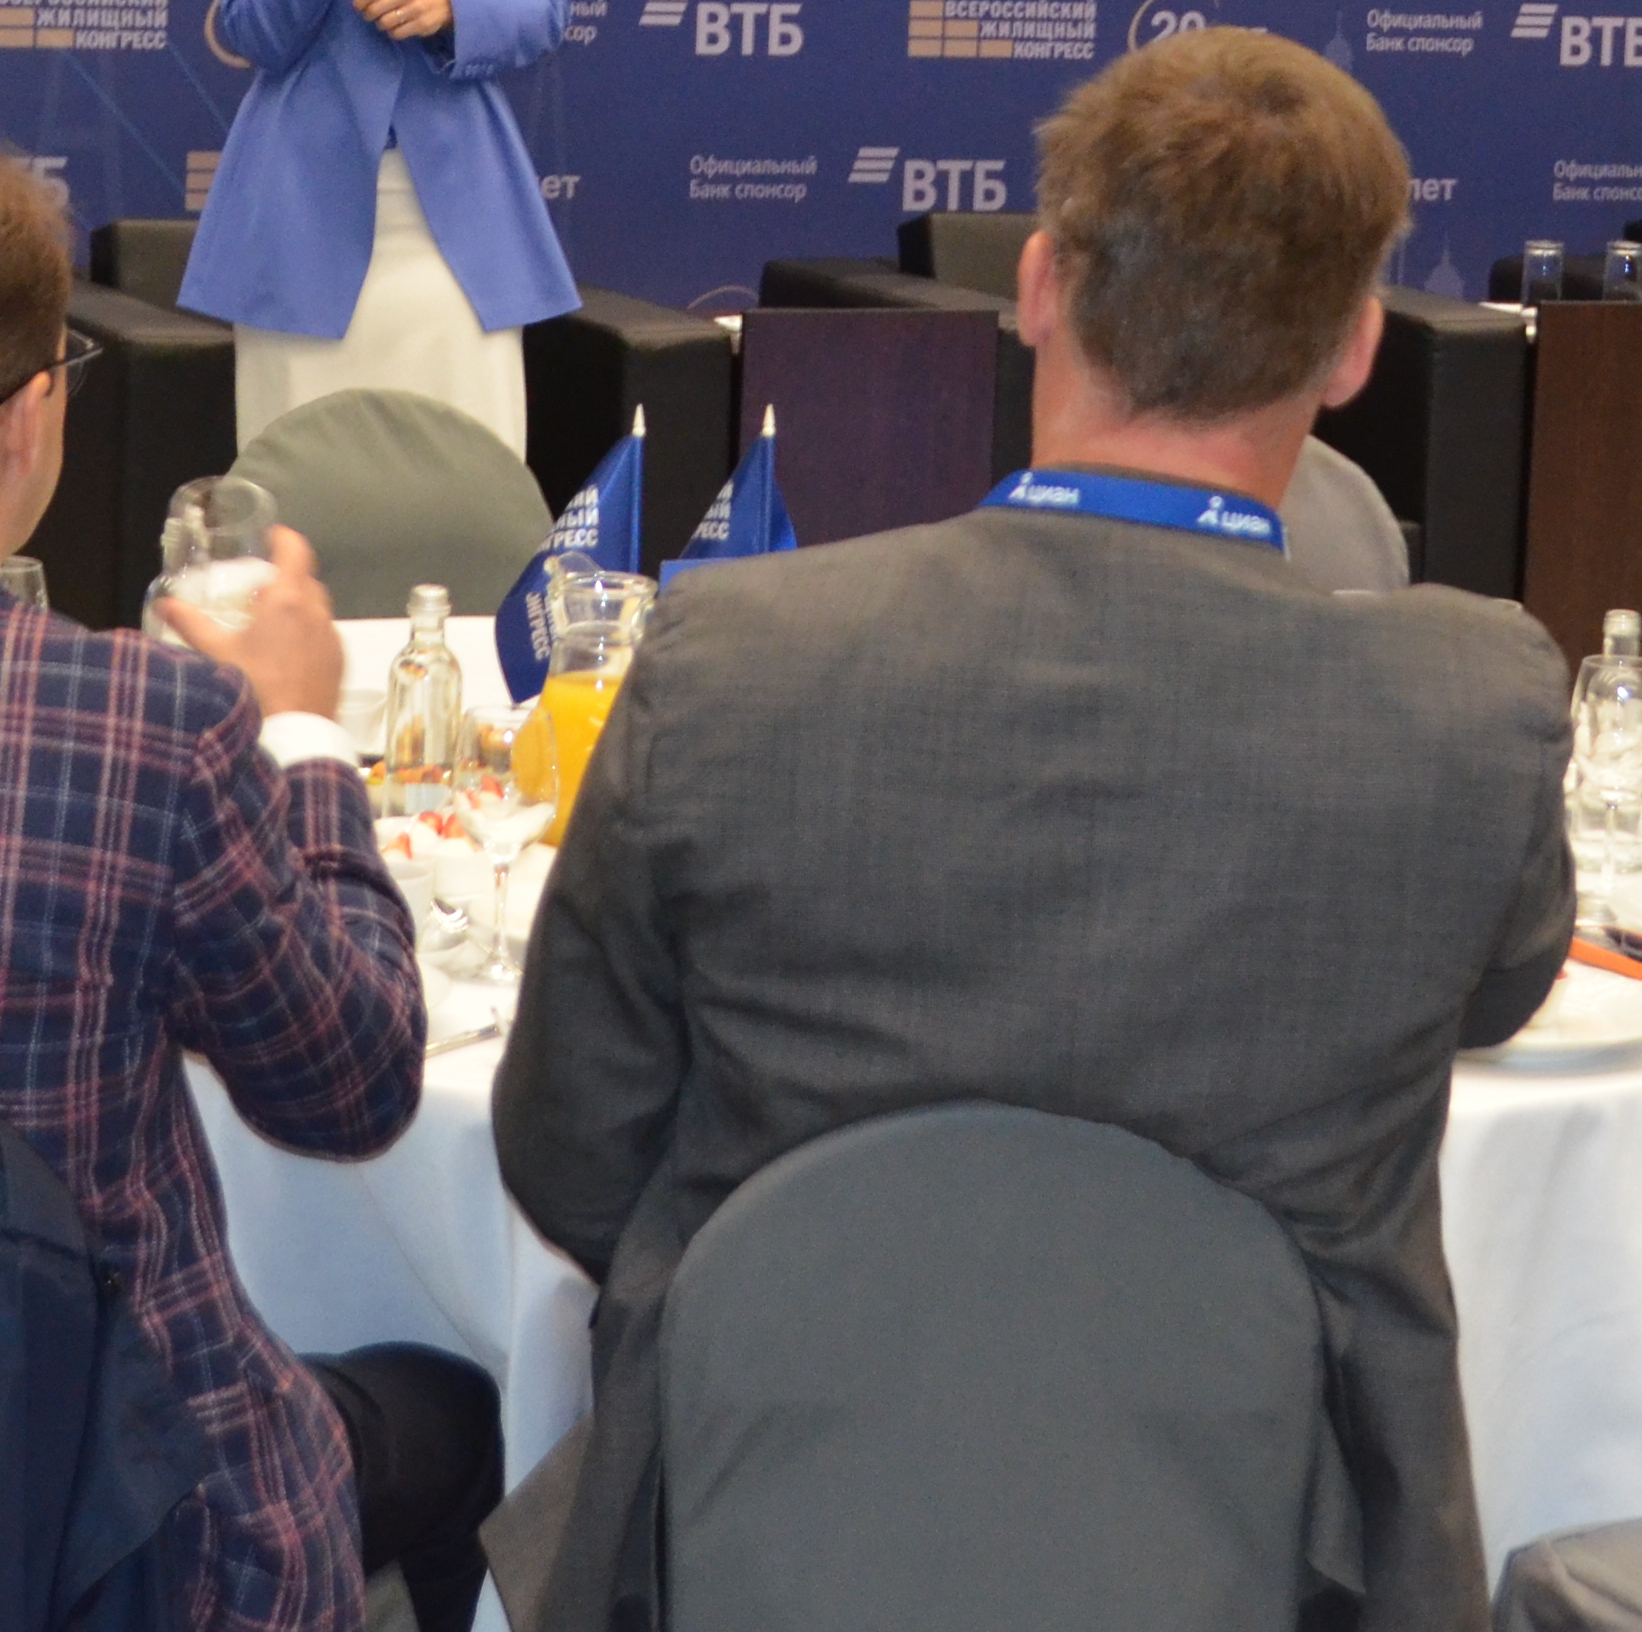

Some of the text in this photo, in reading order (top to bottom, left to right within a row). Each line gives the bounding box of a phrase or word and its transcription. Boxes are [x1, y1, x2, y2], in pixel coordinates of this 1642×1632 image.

[35, 4, 168, 28] ЖИЛИЩНЫЙ
[1366, 9, 1483, 34] Официальный
[73, 28, 168, 50] КОНГРЕСС
[694, 1, 804, 57] ВТБ
[977, 17, 1097, 41] ЖИЛИЩНЫЙ
[1012, 39, 1096, 60] КОНГРЕСС
[1366, 31, 1475, 57] Банк спонсор
[689, 155, 818, 179] Официальный
[537, 174, 581, 200] ет
[689, 178, 806, 204] Банк спонсор
[901, 159, 1007, 212] ВТБ
[1552, 181, 1591, 203] Банк
